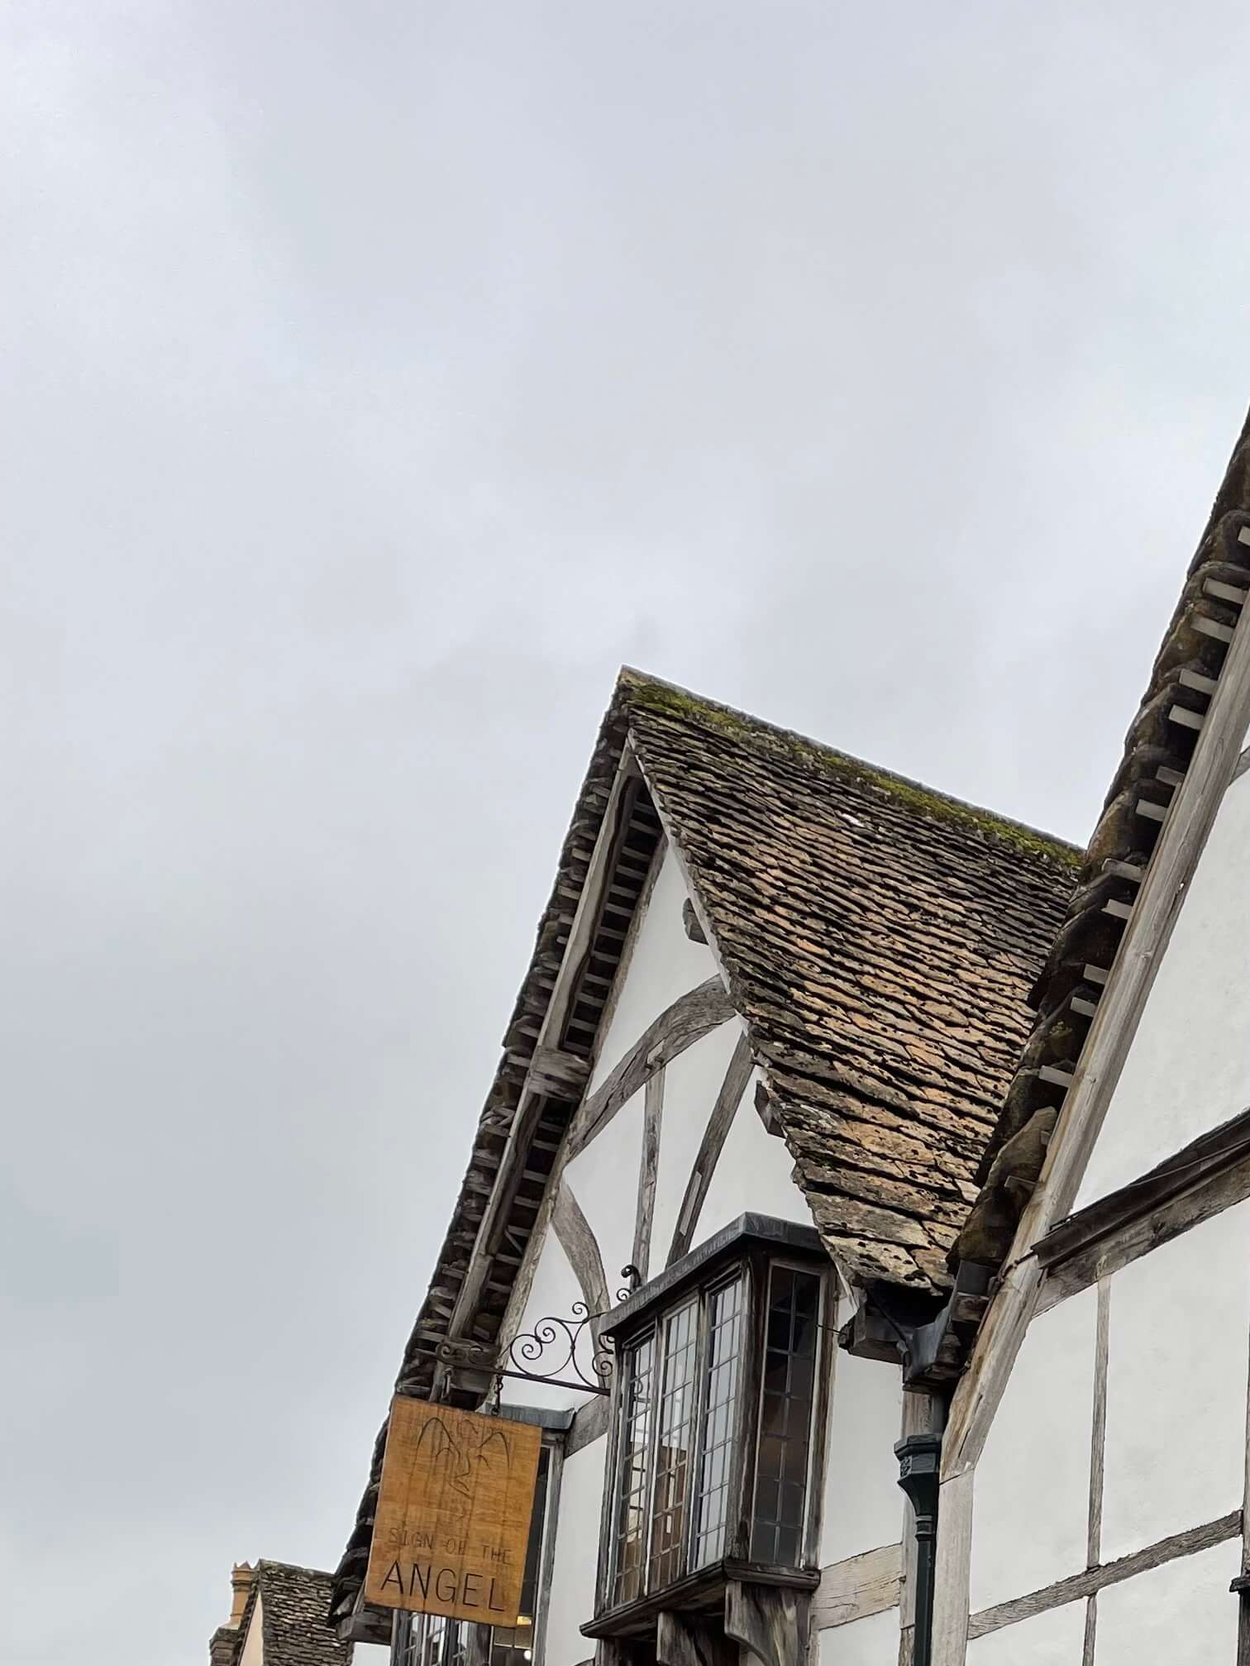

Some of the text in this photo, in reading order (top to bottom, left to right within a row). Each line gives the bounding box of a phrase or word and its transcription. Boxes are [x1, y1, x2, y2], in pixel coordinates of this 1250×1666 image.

[388, 1527, 513, 1566] SIGN OF THE
[380, 1560, 506, 1612] ANGEL
